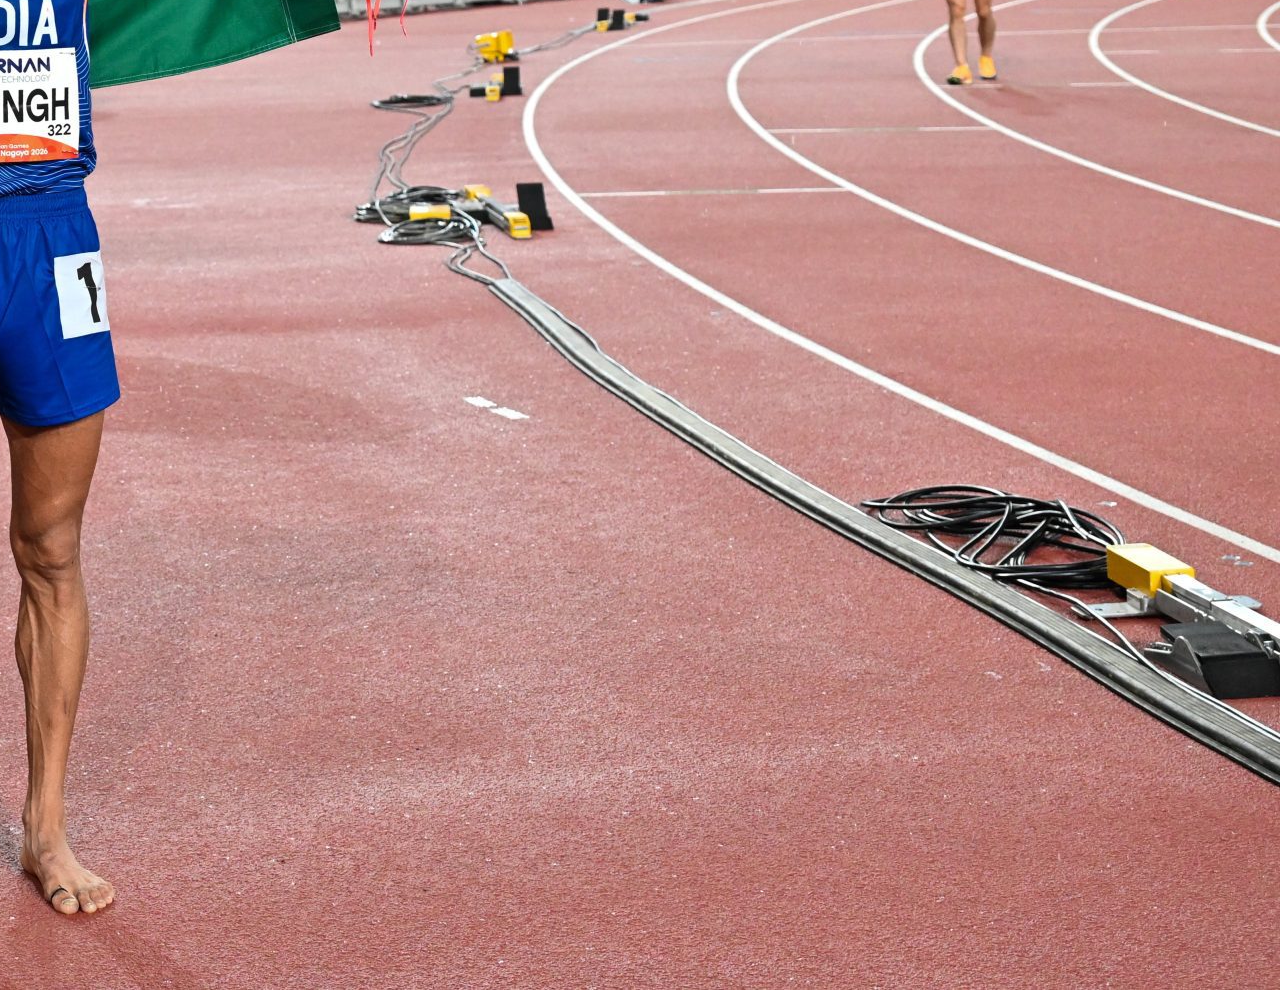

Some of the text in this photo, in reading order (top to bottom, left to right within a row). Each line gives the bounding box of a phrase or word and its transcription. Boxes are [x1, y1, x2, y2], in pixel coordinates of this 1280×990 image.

[47, 123, 72, 137] 322
[30, 148, 49, 156] 2026
[76, 262, 101, 324] 1
